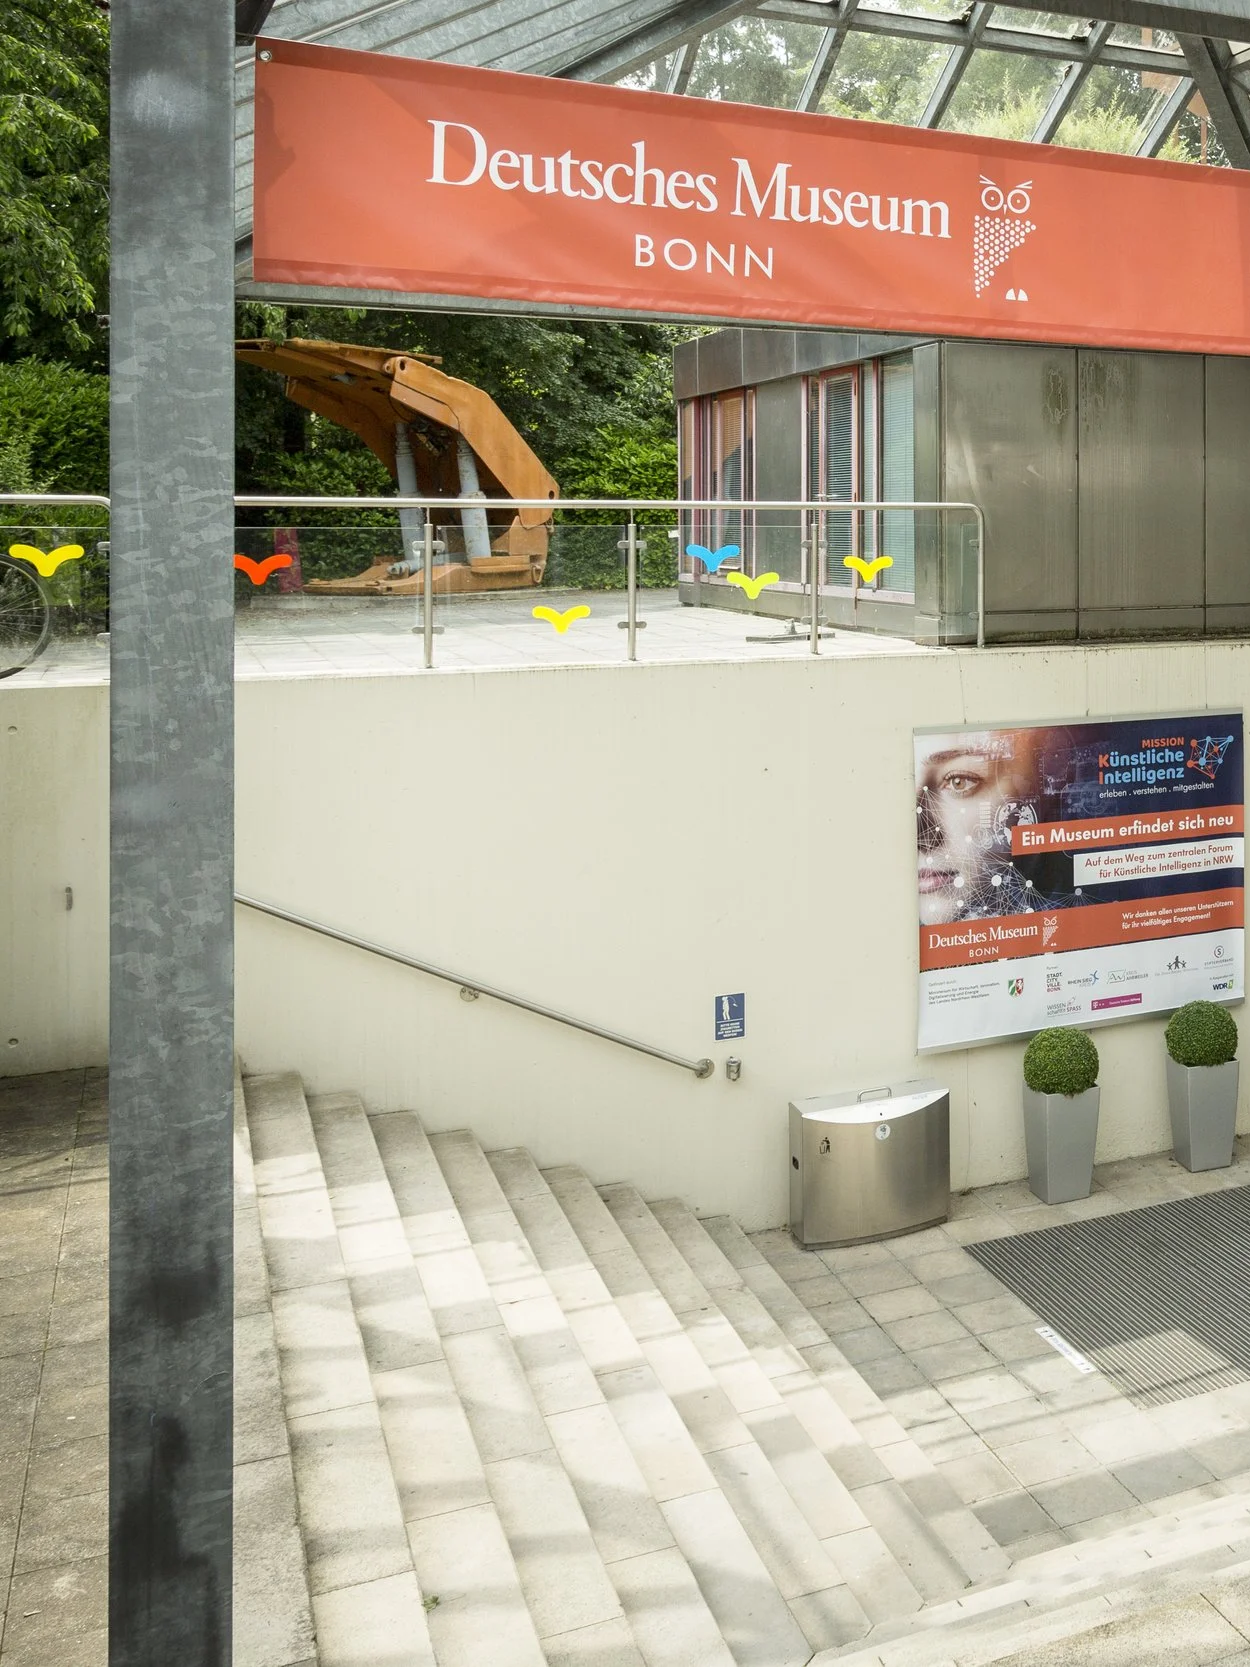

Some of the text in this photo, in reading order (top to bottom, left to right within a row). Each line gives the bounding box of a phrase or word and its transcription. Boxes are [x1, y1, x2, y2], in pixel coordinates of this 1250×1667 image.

[426, 119, 952, 239] Deutsches Museum
[635, 234, 773, 279] BONN
[1142, 737, 1184, 748] MISSION
[1099, 749, 1184, 768] Künstliche
[1099, 767, 1184, 784] Intelligenz
[1100, 782, 1214, 799] erleben verstehen mitgestalten
[1022, 815, 1234, 846] Ein Museum erfindet sich neu
[1085, 844, 1233, 867] Auf dem Weg zum zentralen Forum
[1099, 855, 1234, 879] für Künstliche Intelligenz in NRW
[1122, 900, 1234, 920] Wir danken allen unseren Unterstützern
[1122, 911, 1211, 930] für ihr vielfältiges Engagement!
[929, 925, 1038, 949] Deutsches Museum
[969, 946, 999, 958] BONN
